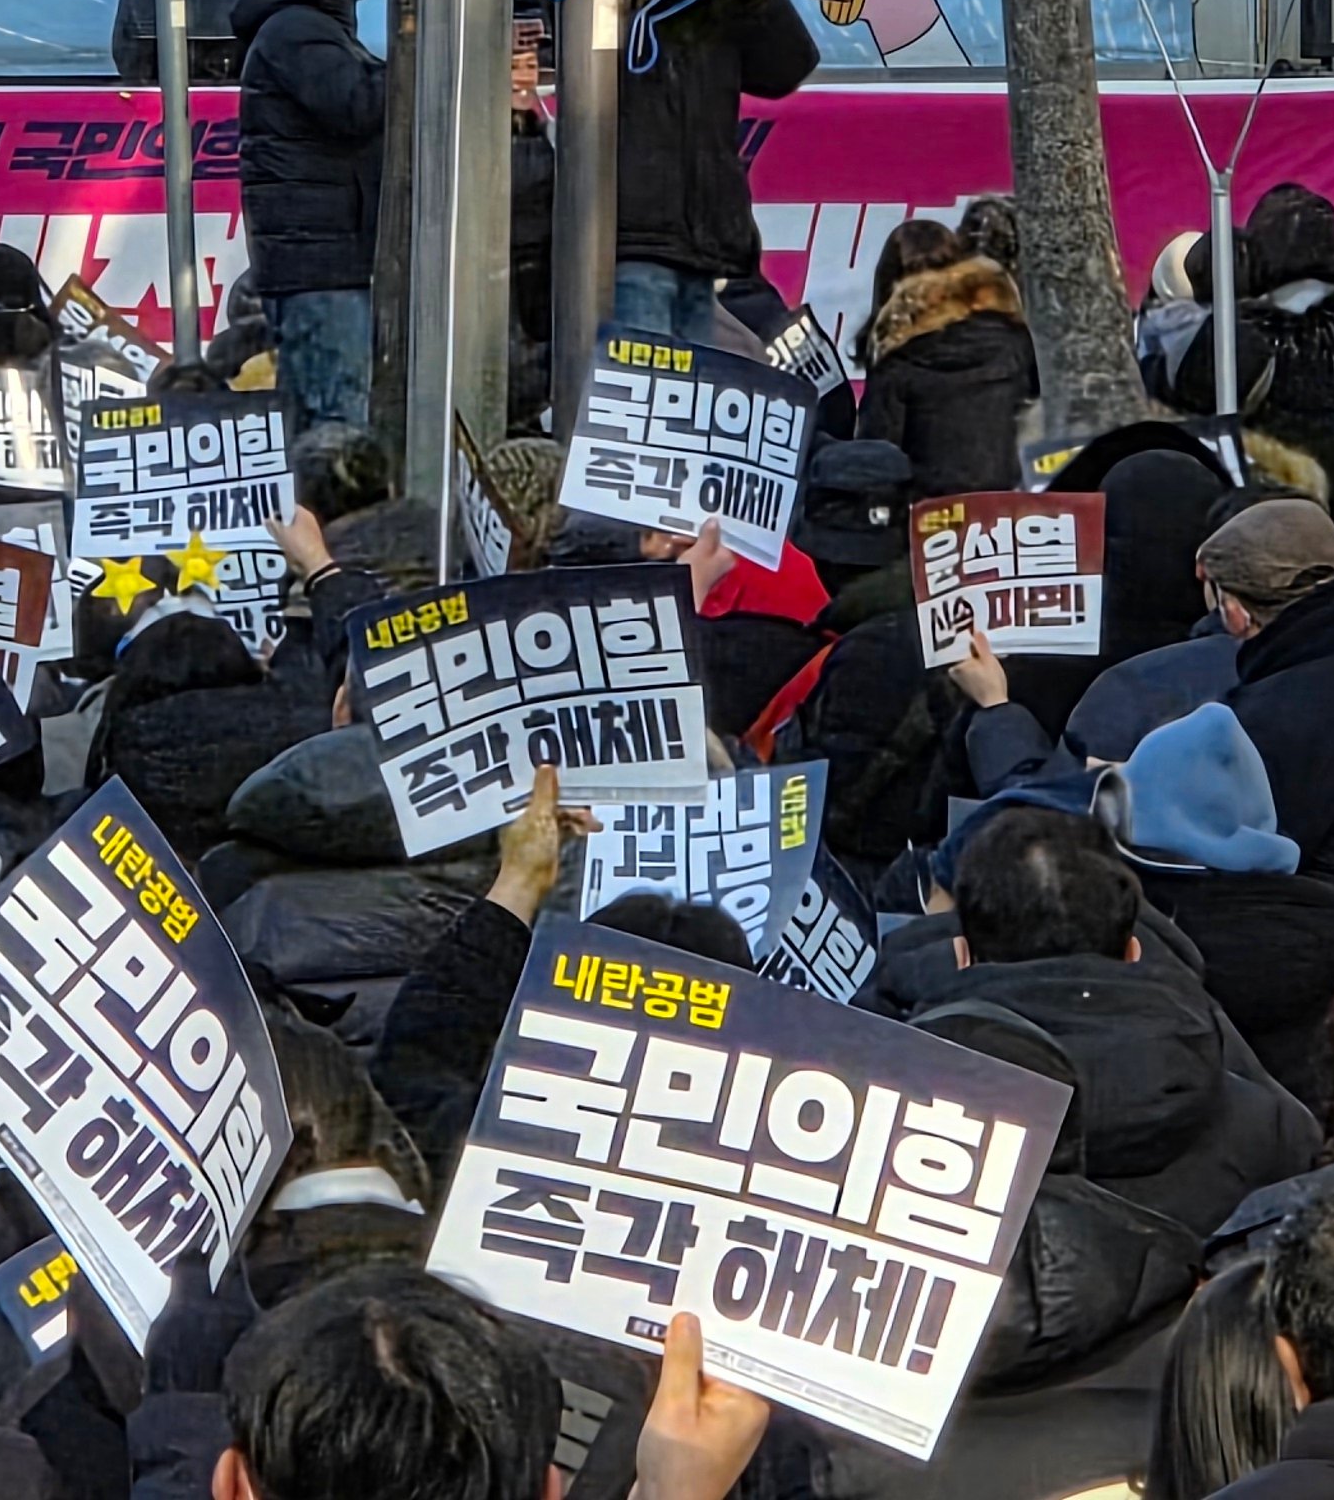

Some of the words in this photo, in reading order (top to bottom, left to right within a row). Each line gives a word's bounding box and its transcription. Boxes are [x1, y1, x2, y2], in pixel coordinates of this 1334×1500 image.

[83, 411, 287, 495] 국민의힘
[586, 367, 808, 478] 국민의힘
[87, 497, 169, 540] 즉각
[582, 444, 691, 512] 즉각
[696, 462, 783, 533] 해체!
[922, 513, 1077, 597] 윤석열
[985, 583, 1086, 631] 파면!
[363, 594, 692, 739] 국민의힘
[400, 722, 516, 821] 즉각
[526, 699, 686, 773] 해체!
[91, 814, 199, 944] 내란공범
[0, 840, 272, 1240] 국민의힘
[552, 952, 732, 1030] 내란공범
[498, 1008, 1027, 1266] 국민의힘
[479, 1166, 701, 1307] 즉각
[712, 1213, 957, 1376] 해체!
